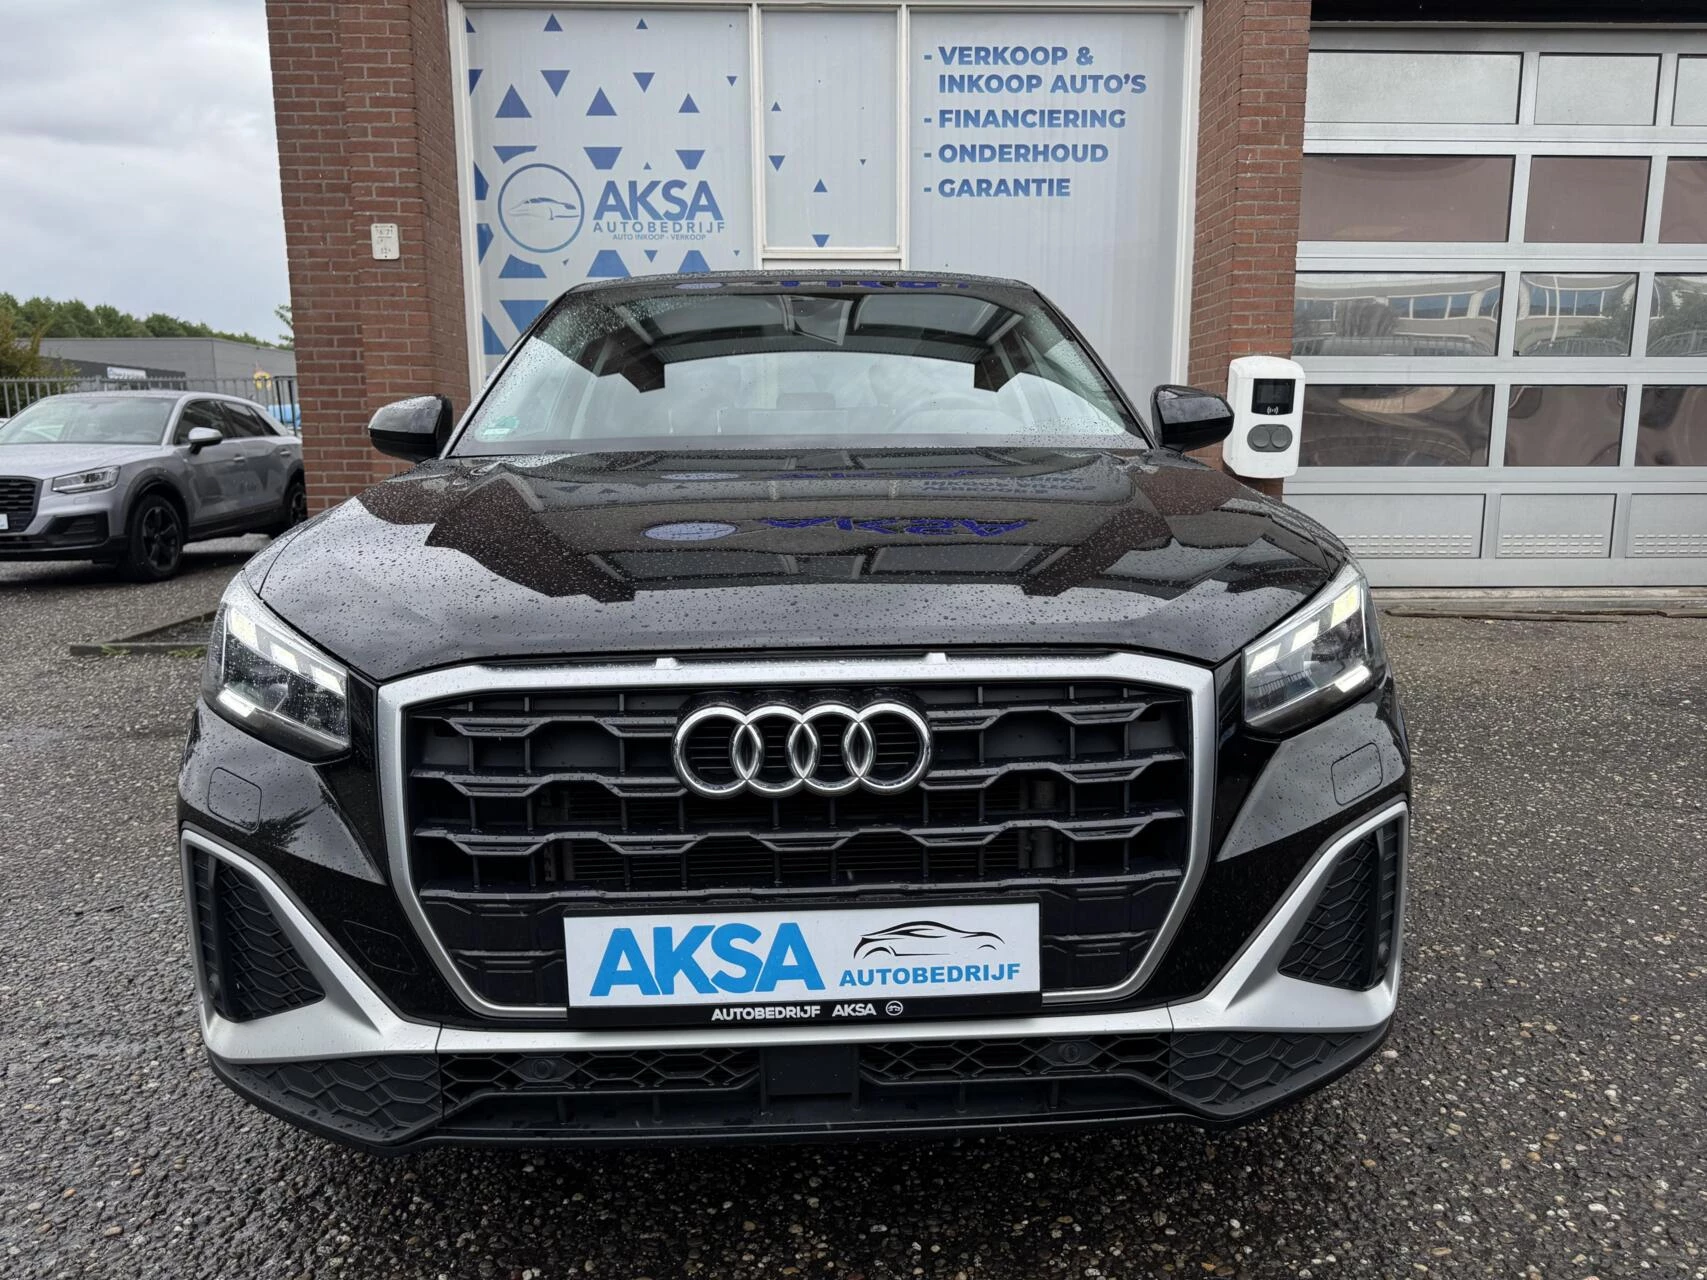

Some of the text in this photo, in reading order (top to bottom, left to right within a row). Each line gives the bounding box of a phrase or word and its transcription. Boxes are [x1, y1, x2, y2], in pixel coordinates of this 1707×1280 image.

[938, 46, 1068, 66] VERKOOP
[1075, 46, 1095, 66] &
[938, 73, 1147, 94] INKOOP AUTO’S
[938, 109, 1126, 129] FINANCIERING
[938, 143, 1109, 163] ONDERHOUD
[938, 178, 1071, 198] GARANTIE
[593, 180, 723, 221] AKSA
[593, 222, 725, 233] AUTOBEDRIJF
[612, 233, 634, 241] AUTO
[635, 233, 665, 241] INKOOP
[671, 233, 706, 241] VERKOOP
[589, 921, 1021, 997] AKSA AUTOBEDRIJF
[711, 1003, 877, 1022] AUTOBEDRIJF AKSA
